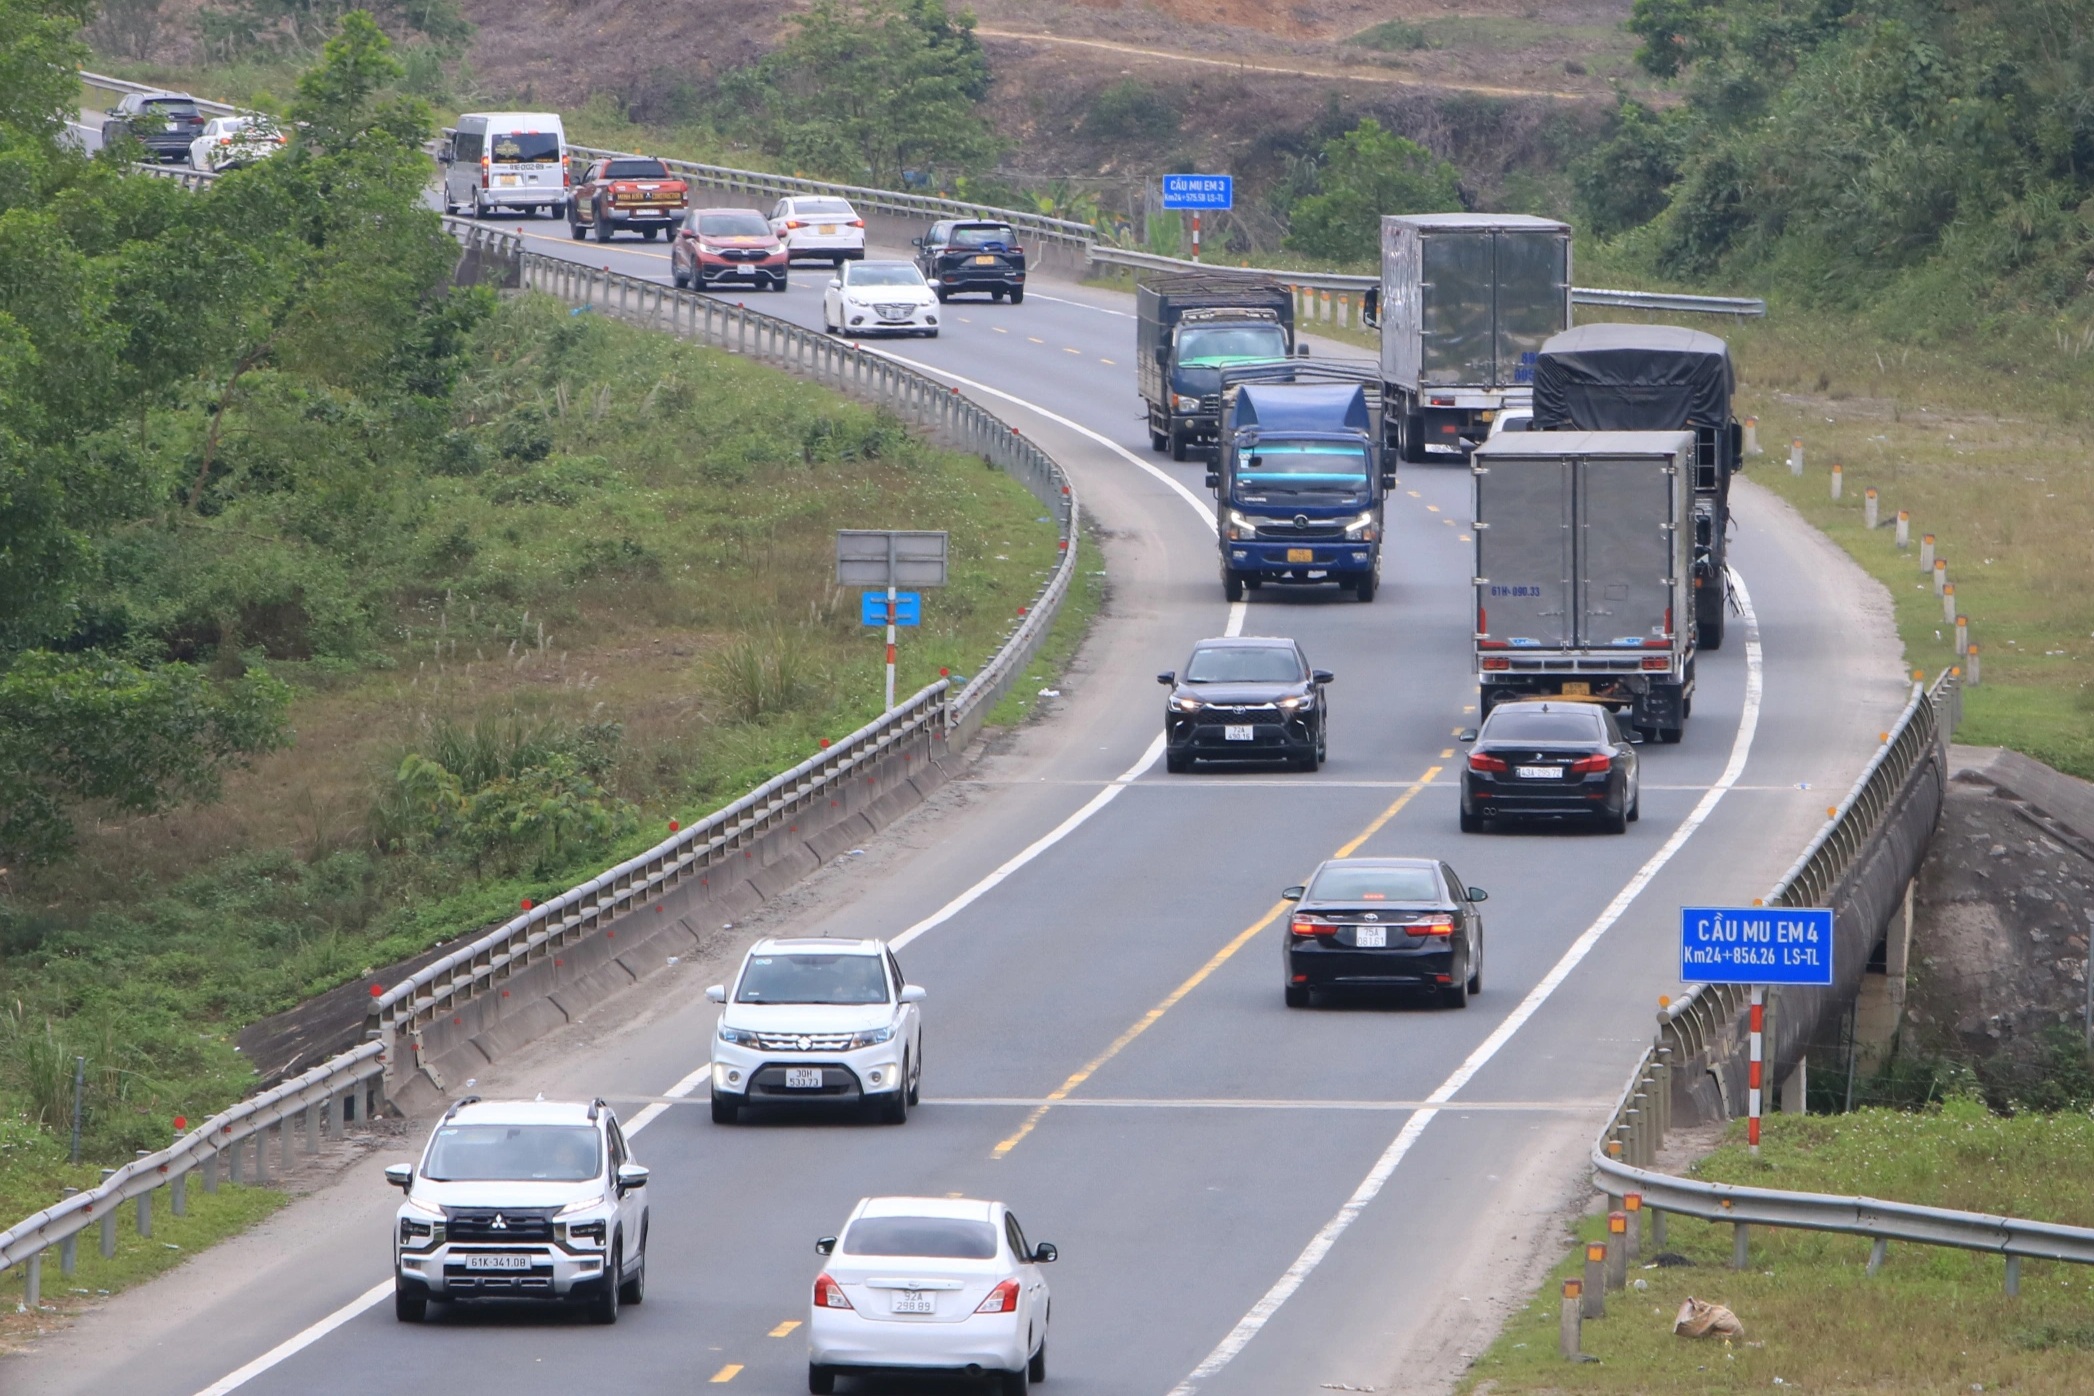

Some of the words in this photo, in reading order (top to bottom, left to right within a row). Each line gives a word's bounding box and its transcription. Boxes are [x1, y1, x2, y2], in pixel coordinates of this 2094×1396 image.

[1189, 180, 1203, 191] MU
[1204, 181, 1217, 191] EM
[1219, 181, 1225, 191] 3
[1364, 927, 1379, 937] 75A
[1698, 912, 1737, 942] CẦU
[1743, 921, 1770, 942] MU
[1777, 921, 1803, 943] EM
[1807, 922, 1818, 943] 4
[1684, 946, 1775, 965] Km24+856.26
[1784, 948, 1819, 965] LS-TL
[471, 1257, 526, 1267] 61K-341.08
[904, 1291, 923, 1301] 92A
